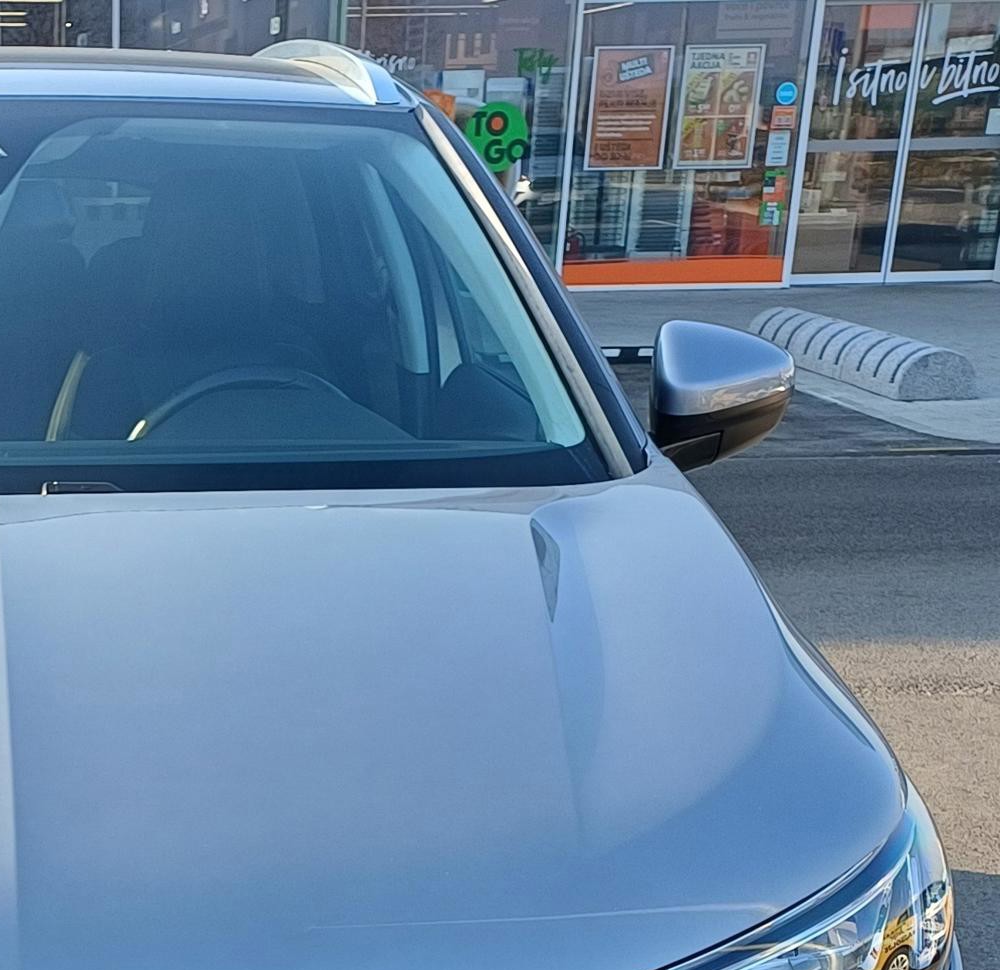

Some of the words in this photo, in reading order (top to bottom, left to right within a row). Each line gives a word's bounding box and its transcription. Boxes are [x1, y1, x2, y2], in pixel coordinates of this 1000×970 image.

[846, 59, 908, 106] sitno
[937, 46, 1000, 98] bitno
[471, 110, 509, 137] TO
[484, 138, 529, 165] GO
